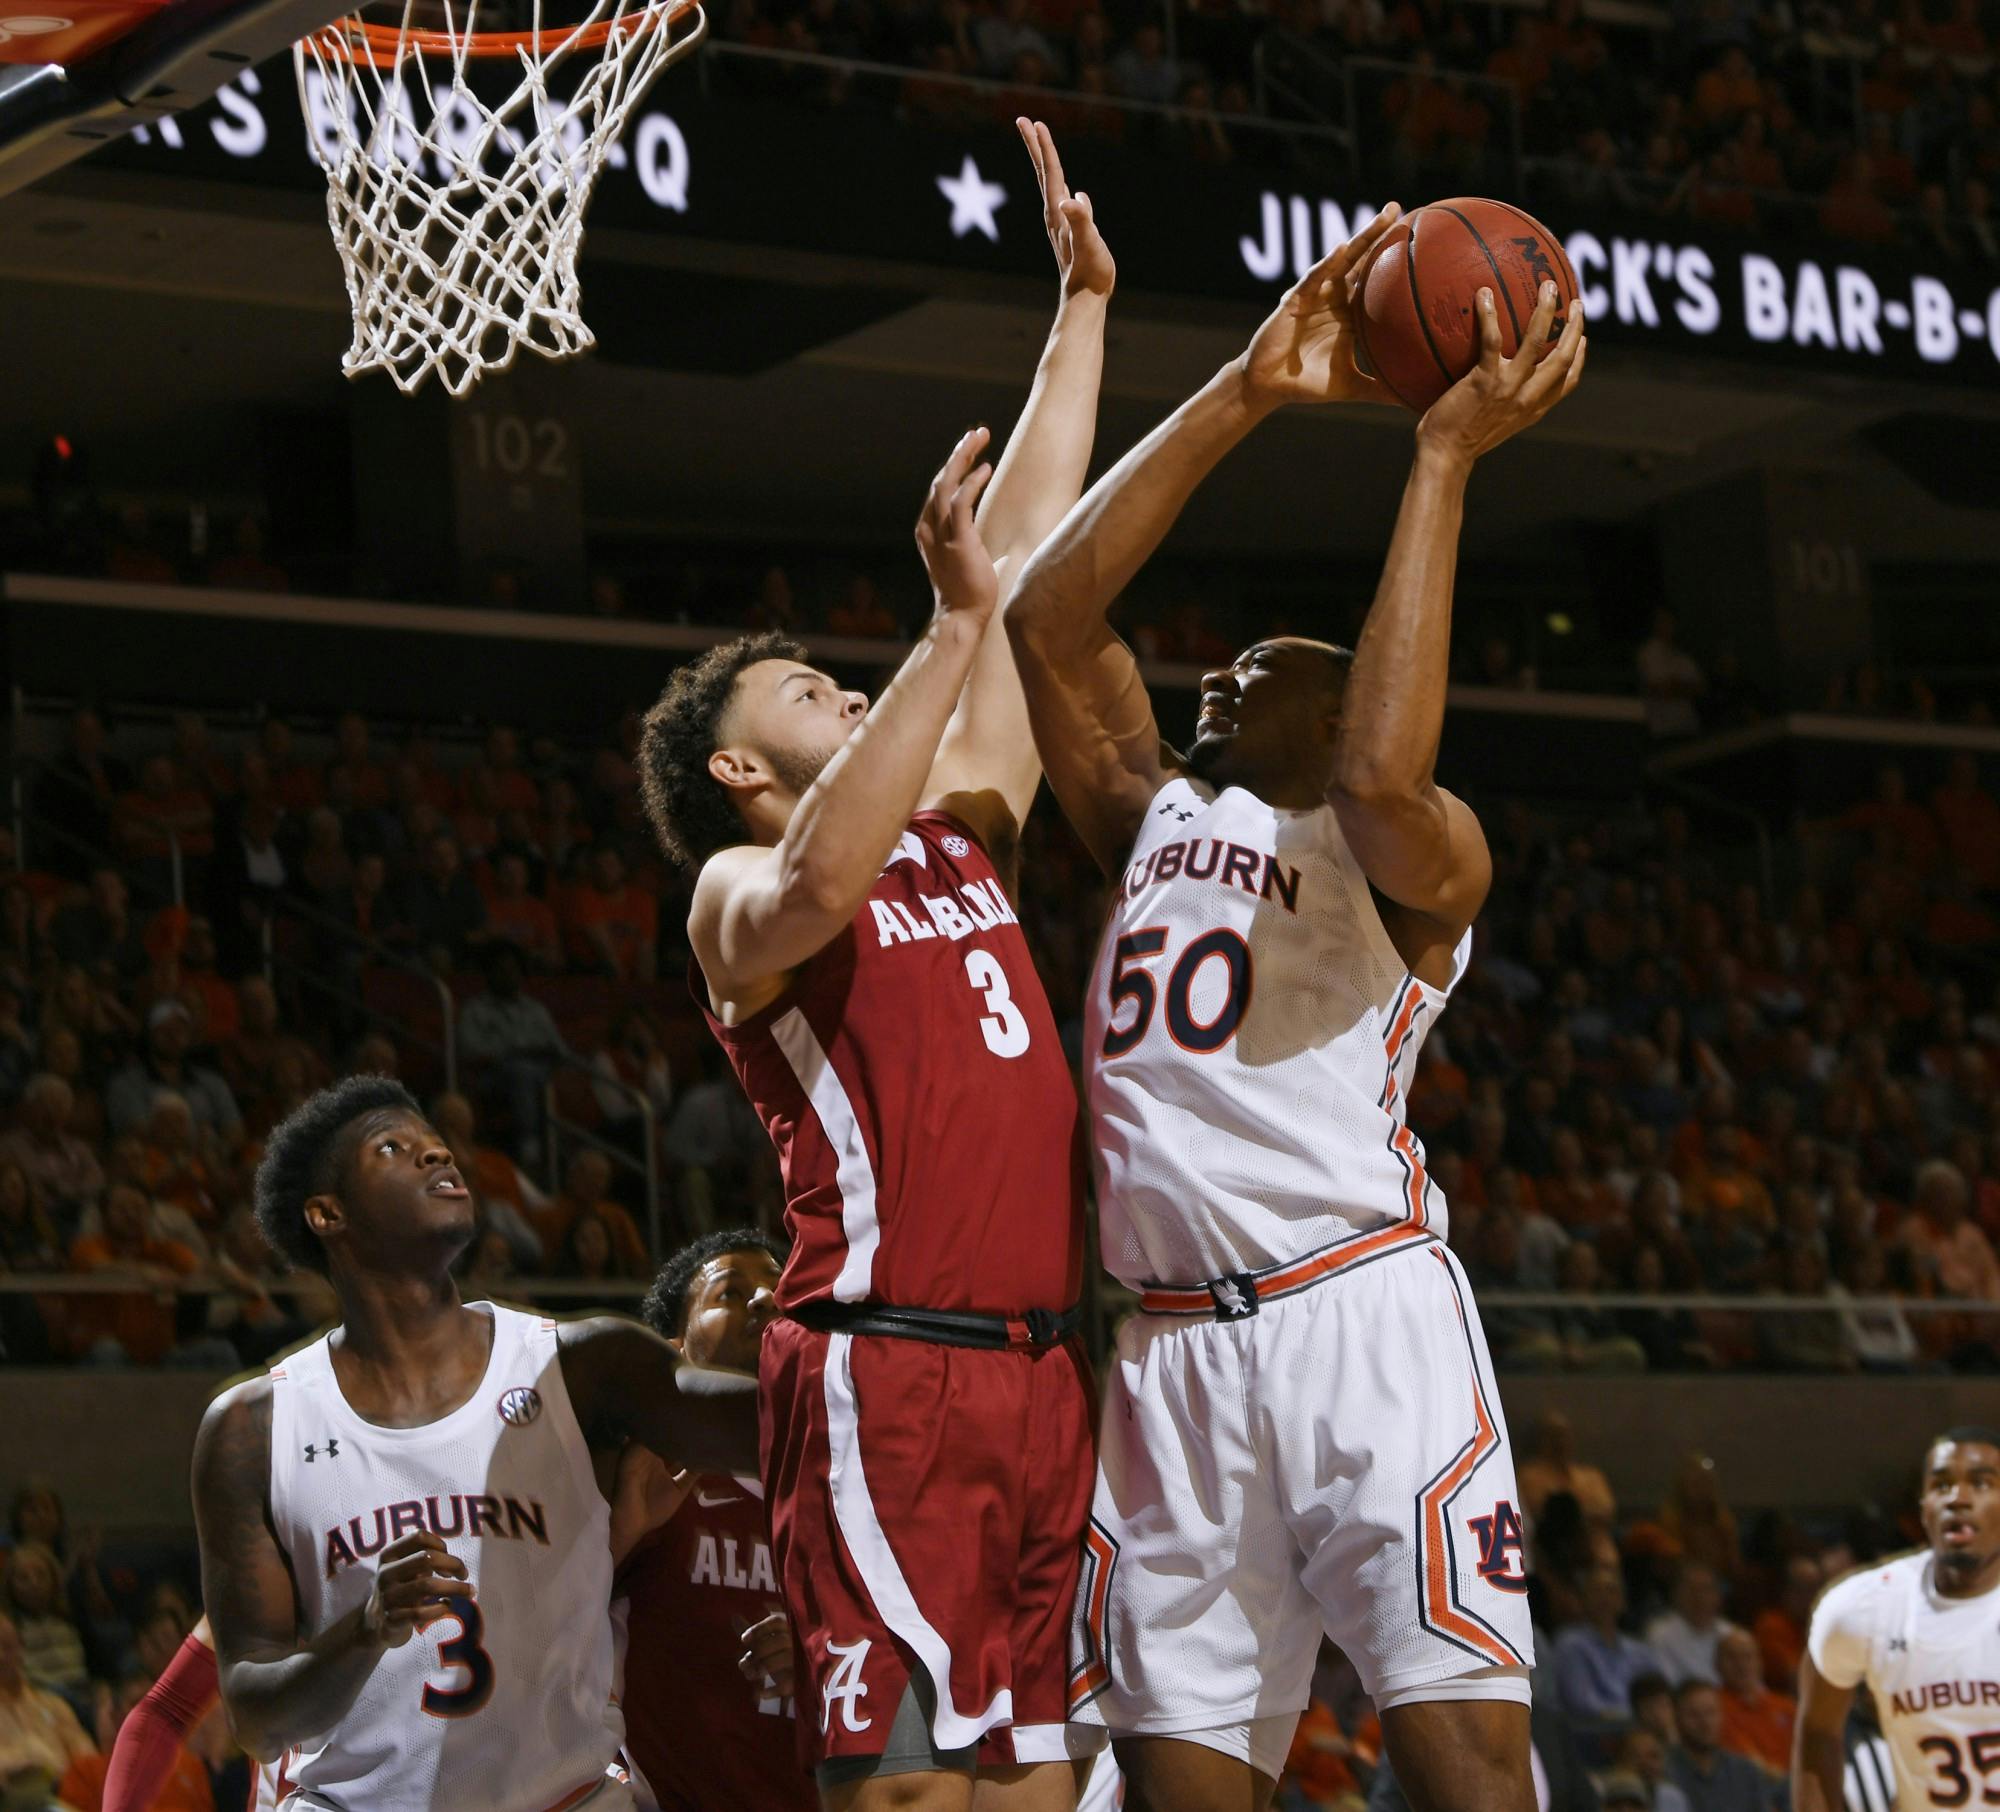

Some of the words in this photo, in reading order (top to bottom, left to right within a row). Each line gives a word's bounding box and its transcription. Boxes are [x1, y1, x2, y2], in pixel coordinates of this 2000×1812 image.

[1511, 237, 1566, 343] NCA
[1565, 230, 1721, 336] CK'S
[470, 413, 567, 477] 102
[868, 877, 1019, 948] ALBM
[1108, 838, 1302, 916] UBURN
[964, 949, 1031, 1058] 3
[1103, 926, 1254, 1060] 50
[326, 1495, 550, 1579] AUBURN
[690, 1535, 784, 1593] ALA
[414, 1596, 496, 1718] 3
[1918, 1732, 2000, 1808] 35
